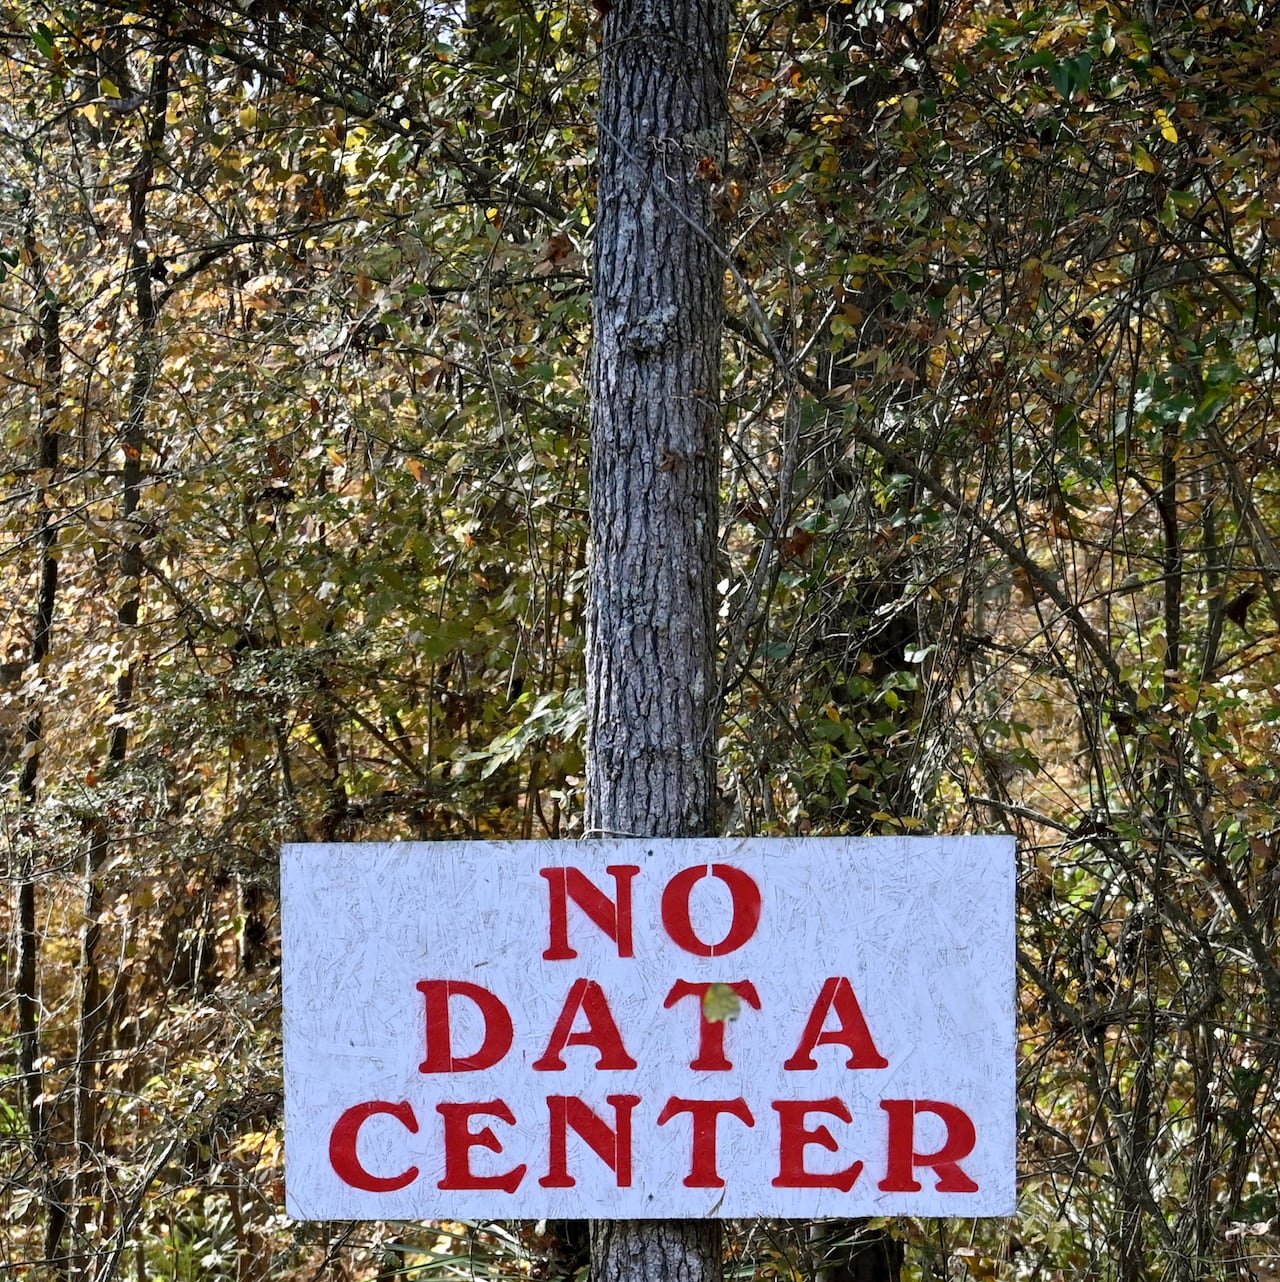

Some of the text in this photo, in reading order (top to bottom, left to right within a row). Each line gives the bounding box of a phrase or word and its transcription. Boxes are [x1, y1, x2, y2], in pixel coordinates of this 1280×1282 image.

[539, 863, 762, 961] NO
[416, 976, 889, 1075] DATA
[328, 1094, 979, 1194] CENTER
